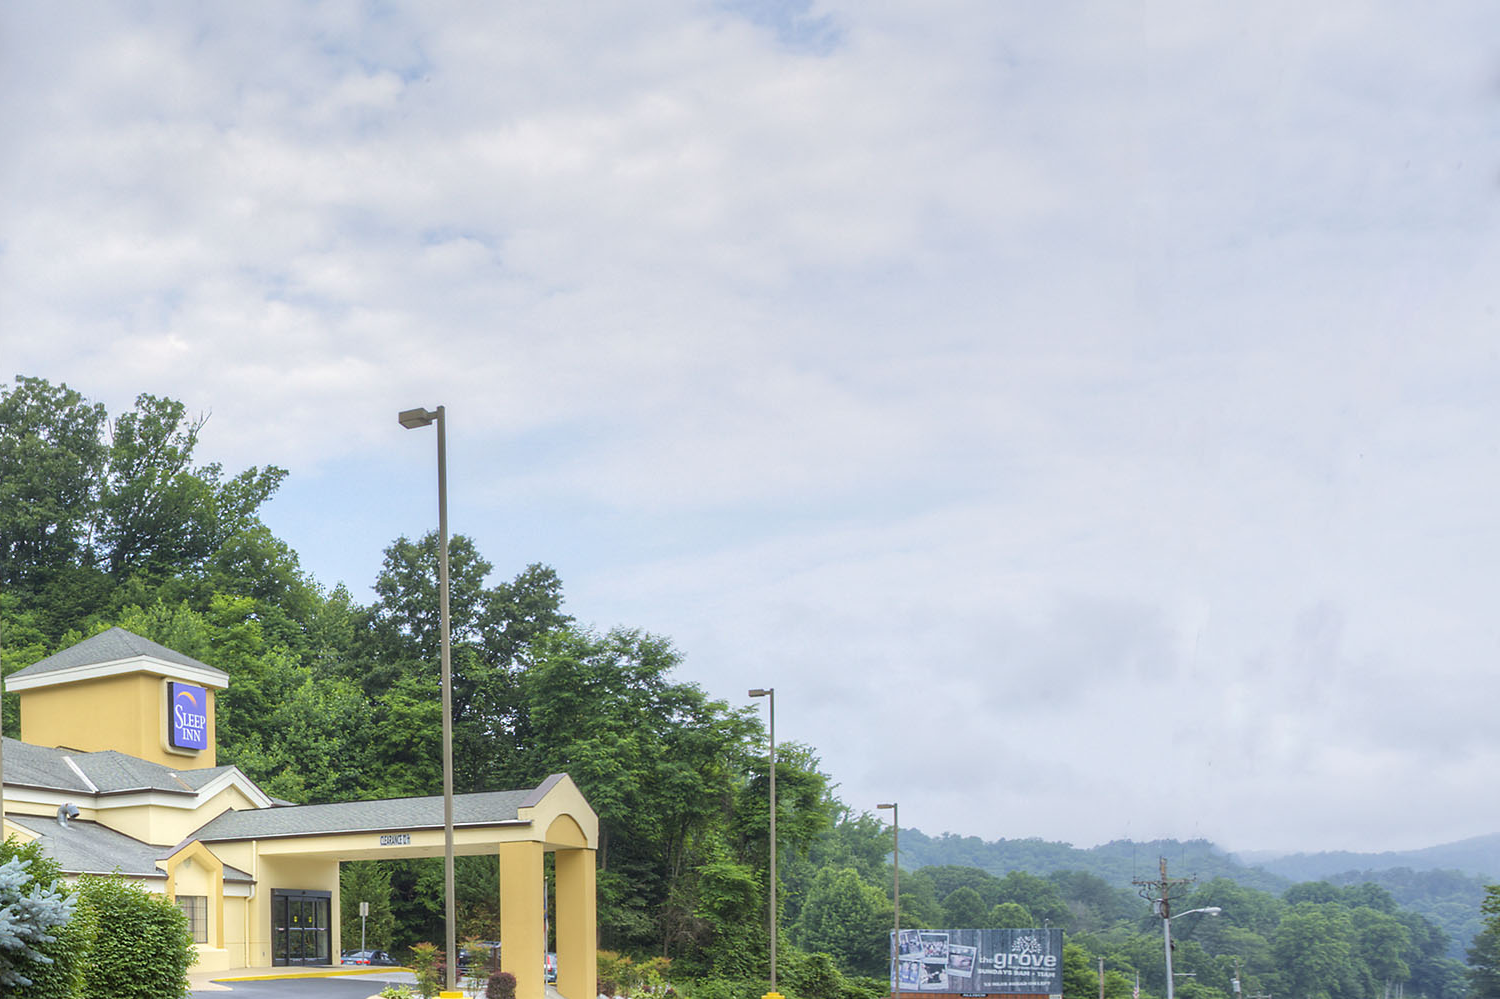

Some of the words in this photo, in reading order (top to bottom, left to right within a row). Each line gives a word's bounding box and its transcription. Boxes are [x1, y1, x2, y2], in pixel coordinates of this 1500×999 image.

[175, 704, 206, 729] SLEEP
[182, 728, 201, 742] INN
[993, 953, 1057, 968] grove
